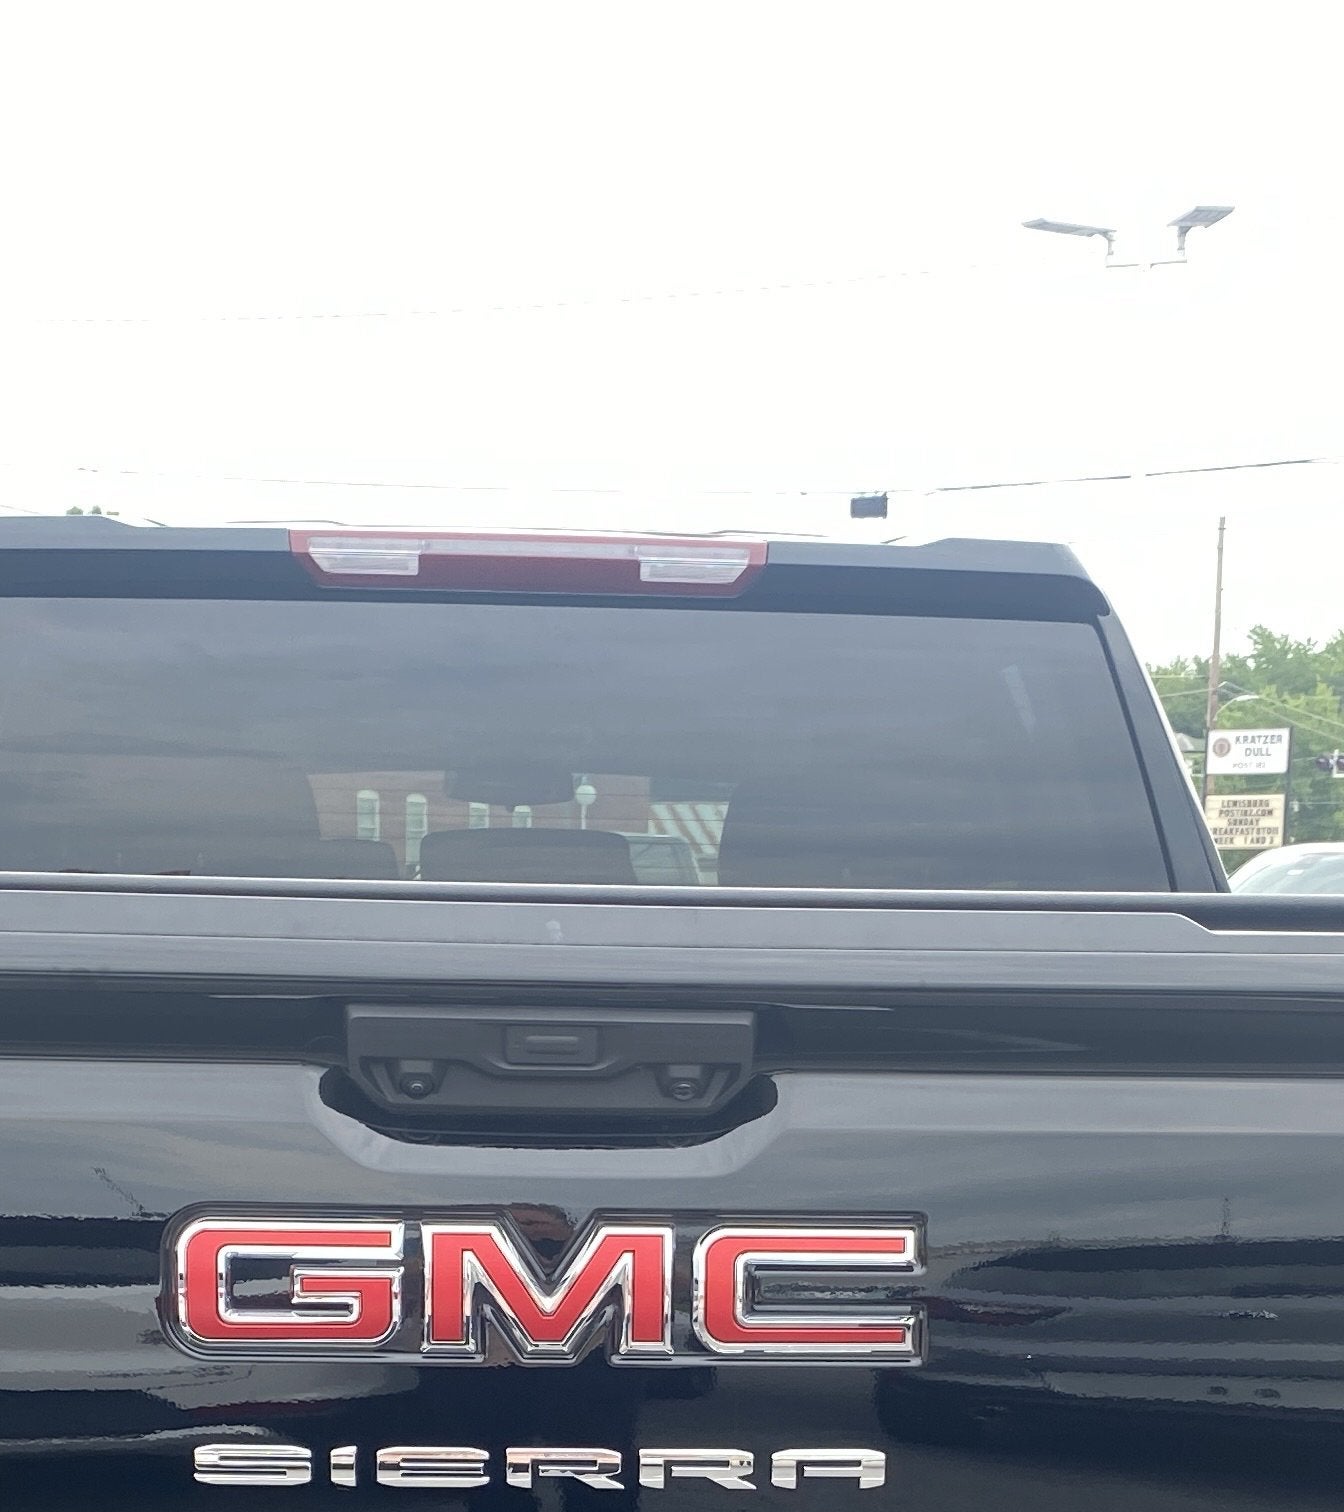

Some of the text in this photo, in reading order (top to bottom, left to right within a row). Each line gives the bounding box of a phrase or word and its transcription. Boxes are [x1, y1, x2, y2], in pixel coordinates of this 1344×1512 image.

[1235, 735, 1282, 744] KRATZER
[1245, 747, 1272, 757] DULL
[1228, 818, 1260, 826] SUNDAY
[1211, 827, 1255, 835] REAKFAST
[168, 1208, 923, 1359] GMC
[193, 1443, 887, 1490] SIERRA
